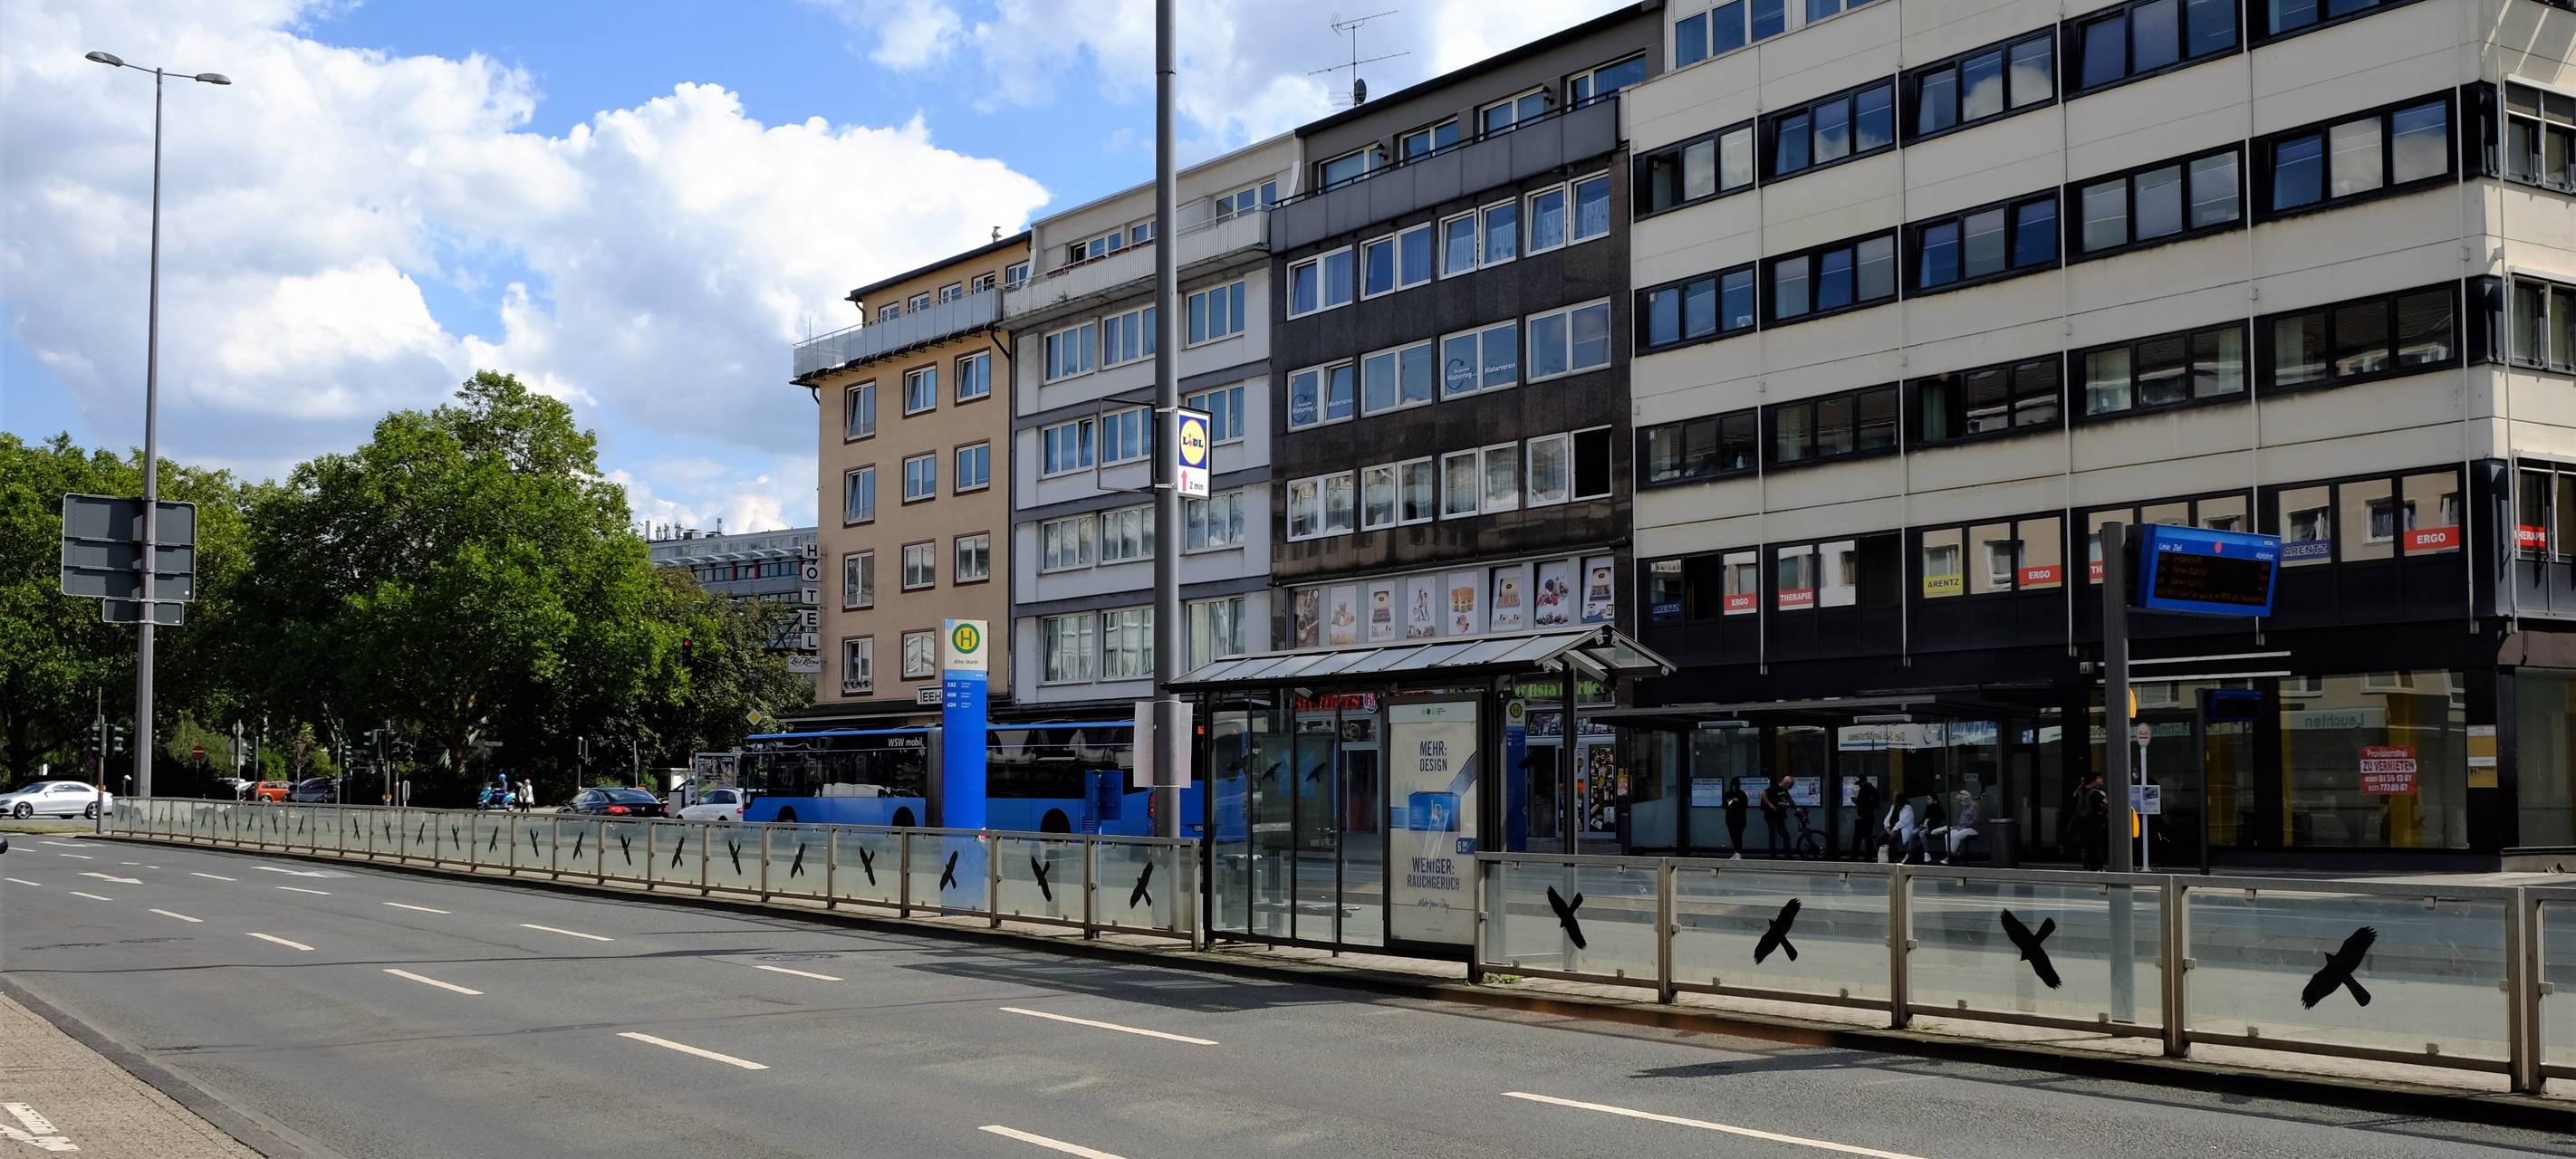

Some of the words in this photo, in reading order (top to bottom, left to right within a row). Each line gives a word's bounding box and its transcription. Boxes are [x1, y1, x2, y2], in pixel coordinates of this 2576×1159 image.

[1484, 362, 1516, 374] Mieterverein
[1189, 481, 1194, 490] 2
[1194, 481, 1205, 491] min
[2417, 532, 2446, 544] ERGO
[2158, 542, 2171, 551] Linie
[2172, 543, 2183, 551] Ziel
[2284, 541, 2328, 552] ARENTZ
[2028, 570, 2051, 580] ERGO
[2091, 565, 2103, 574] TH
[1927, 579, 1960, 589] ARENTZ
[806, 544, 818, 647] HOTEL
[1779, 591, 1812, 602] THERAPIE
[1731, 598, 1749, 607] ERGO
[1652, 604, 1681, 614] ARENTZ
[960, 629, 972, 647] H
[888, 738, 905, 747] WSW
[906, 736, 923, 747] mobil
[1419, 741, 1447, 756] MEHR:
[1419, 759, 1447, 771] DESIGN
[2363, 761, 2373, 771] ZU
[2373, 761, 2415, 771] VERMIETEN
[1412, 857, 1455, 876] WENIGER:
[1407, 875, 1460, 891] RAUCHGERUCH
